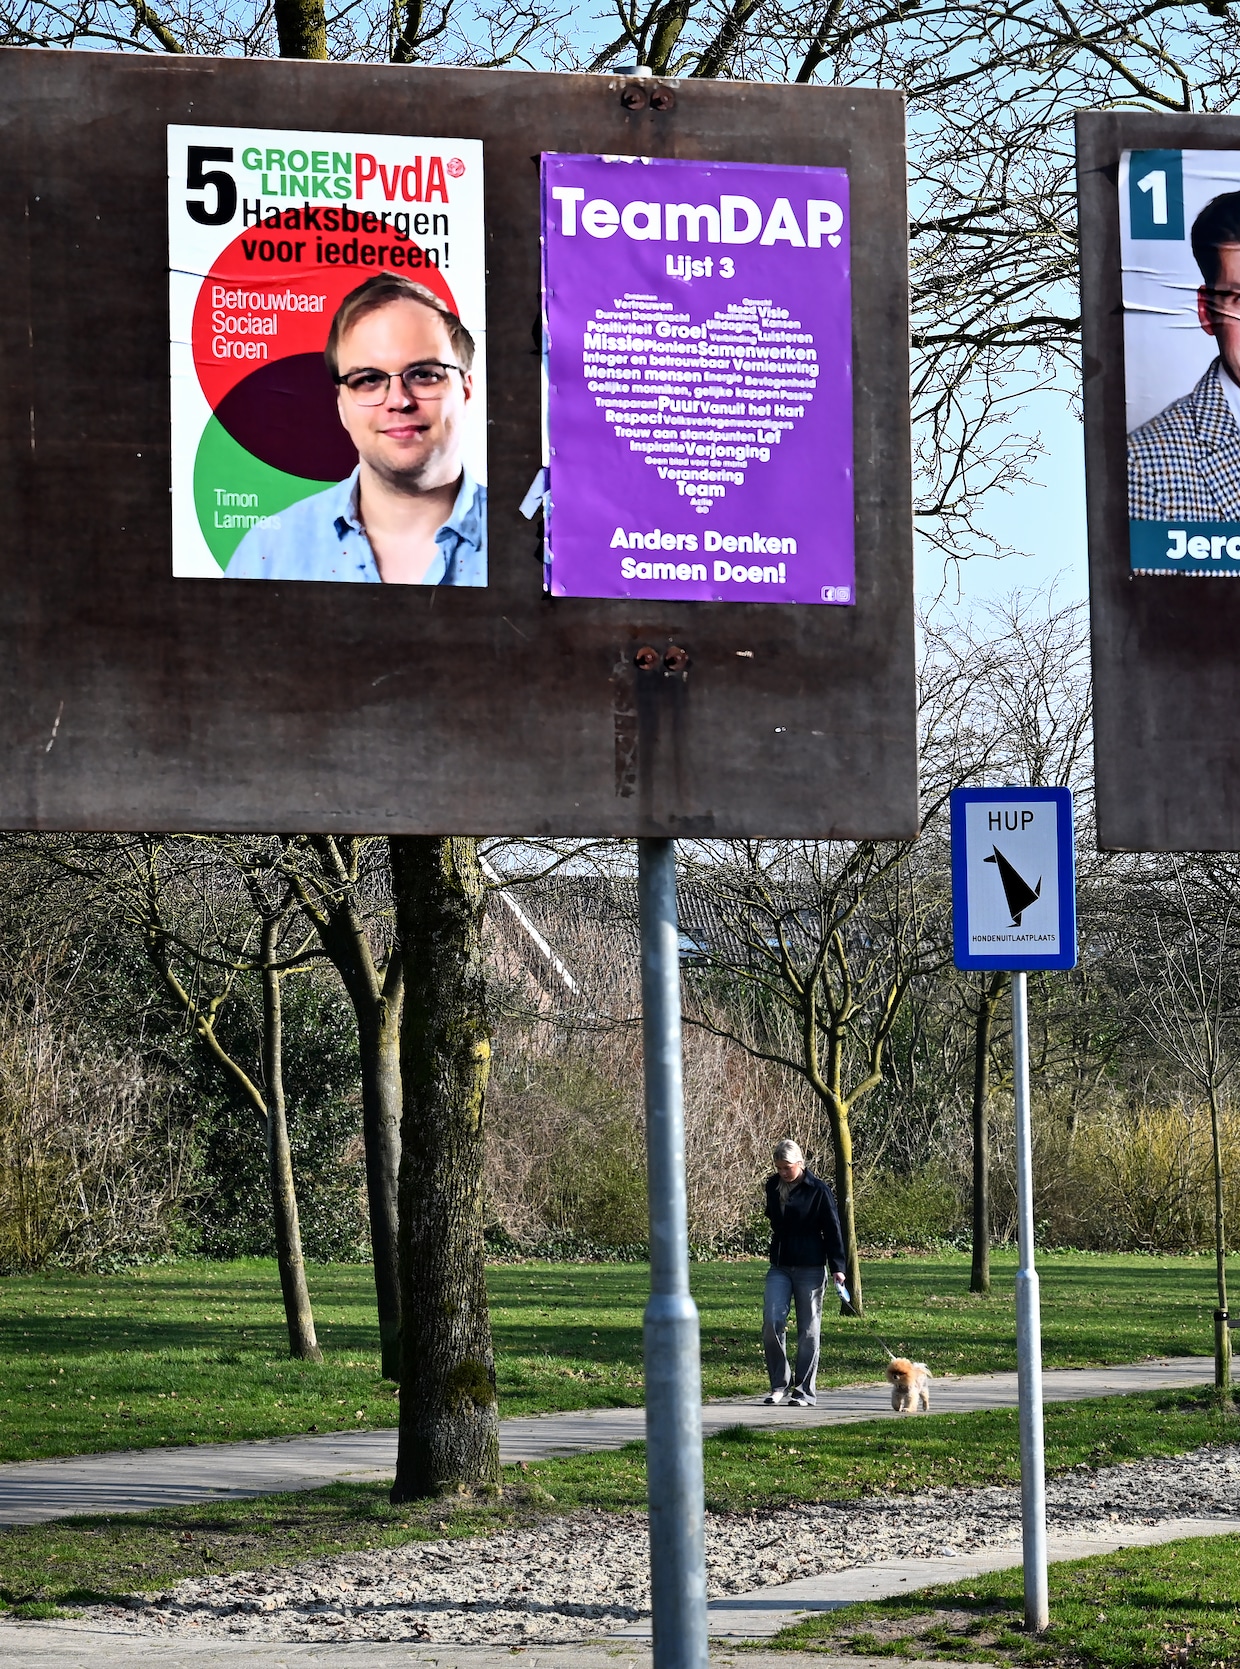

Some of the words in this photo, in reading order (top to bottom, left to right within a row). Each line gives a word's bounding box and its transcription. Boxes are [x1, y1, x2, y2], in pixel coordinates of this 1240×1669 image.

[242, 148, 352, 174] GROEN
[186, 145, 237, 225] 5
[262, 174, 352, 199] LINKS
[355, 153, 449, 203] PvdA
[1137, 170, 1168, 224] 1
[243, 199, 449, 241] Haaksbergen
[242, 238, 306, 263] voor
[316, 236, 450, 269] iedereen!
[665, 254, 714, 281] Lijst
[719, 256, 736, 279] 3
[211, 286, 327, 313] Betrouwbaar
[614, 299, 673, 311] Vertrouwen
[211, 311, 277, 335] Sociaal
[758, 306, 790, 319] Visie
[587, 320, 652, 335] Positiviteit
[656, 322, 707, 340] Groei
[758, 330, 813, 344] Luisteren
[211, 336, 267, 359] Groen
[584, 333, 644, 352] Missie
[644, 340, 698, 354] Pioniers
[698, 341, 817, 361] Samenwerken
[583, 351, 629, 366] Integer
[630, 355, 648, 366] en
[649, 354, 730, 369] betrouwbaar
[733, 358, 819, 378] Vernieuwing
[584, 364, 641, 380] Mensen
[644, 370, 702, 383] mensen
[588, 380, 630, 394] Gelijke
[632, 383, 692, 397] monniken,
[735, 387, 780, 400] kappen
[606, 410, 662, 426] Respect
[658, 396, 700, 413] Puur
[700, 401, 746, 416] Vanuit
[748, 403, 771, 416] het
[774, 404, 804, 418] Hart
[614, 426, 650, 438] Trouw
[653, 430, 678, 439] aan
[680, 429, 756, 442] standpunten
[630, 440, 685, 453] Inspiratie
[685, 442, 770, 462] Verjonging
[657, 466, 744, 485] Verandering
[214, 488, 258, 508] Timon
[676, 480, 726, 497] Team
[214, 511, 281, 530] Lammers
[610, 527, 699, 551] Anders
[704, 530, 797, 554] Denken
[621, 557, 707, 581] Samen
[713, 560, 786, 584] Doen!
[988, 810, 1034, 831] HUP
[972, 934, 1056, 942] HONDENUITLAATPLAATS
